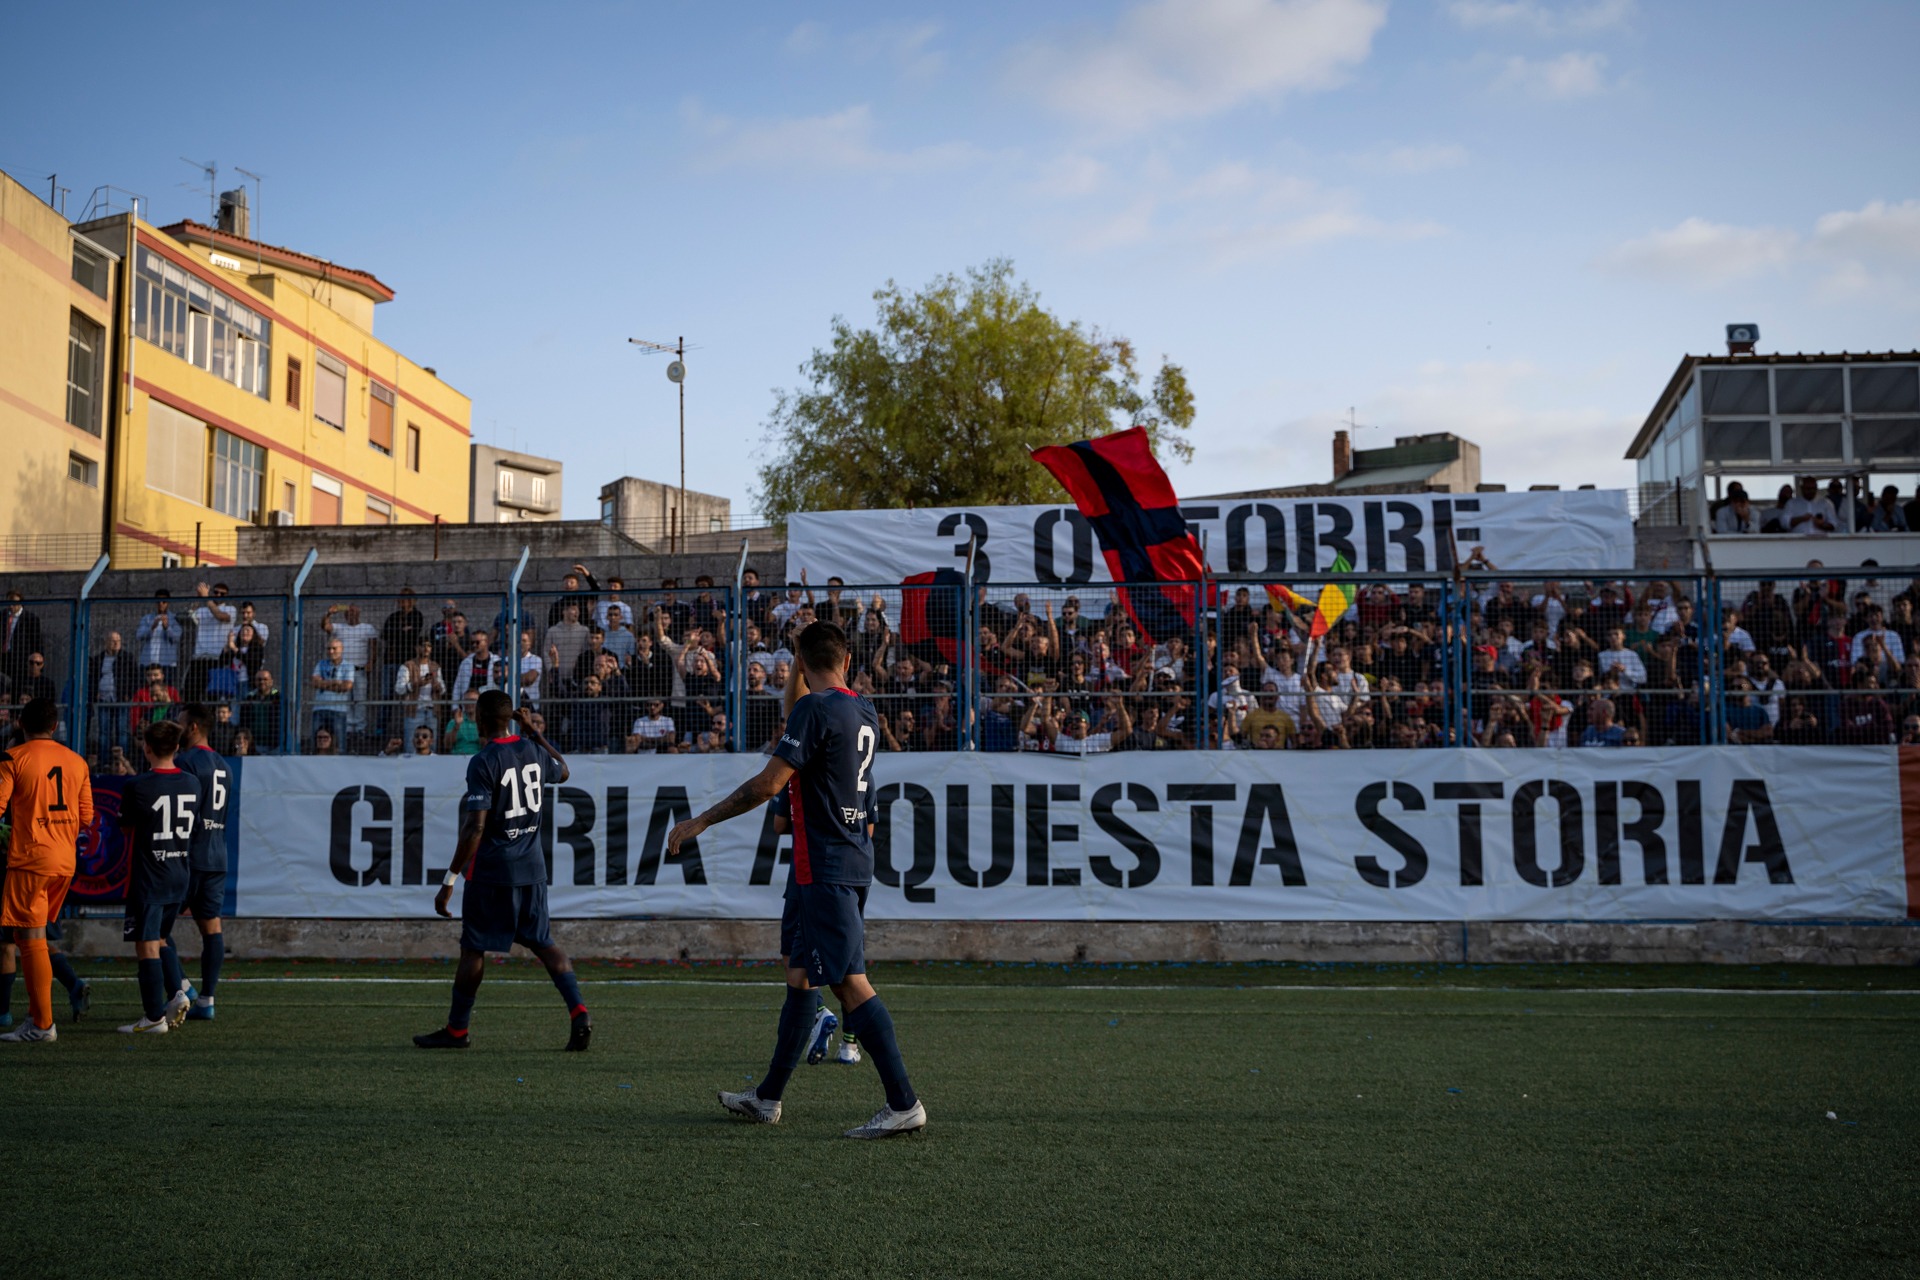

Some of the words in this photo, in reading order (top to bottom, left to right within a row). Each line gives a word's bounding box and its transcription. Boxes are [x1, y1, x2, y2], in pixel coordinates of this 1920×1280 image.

[936, 512, 991, 583] 3
[1033, 498, 1481, 591] OOBRE
[856, 724, 876, 792] 2
[46, 765, 68, 812] 1
[212, 769, 227, 811] 6
[500, 762, 542, 819] 18
[151, 794, 197, 841] 15
[329, 784, 708, 887] GLRIA
[871, 782, 1307, 904] QUESTA
[1353, 778, 1796, 889] STORIA
